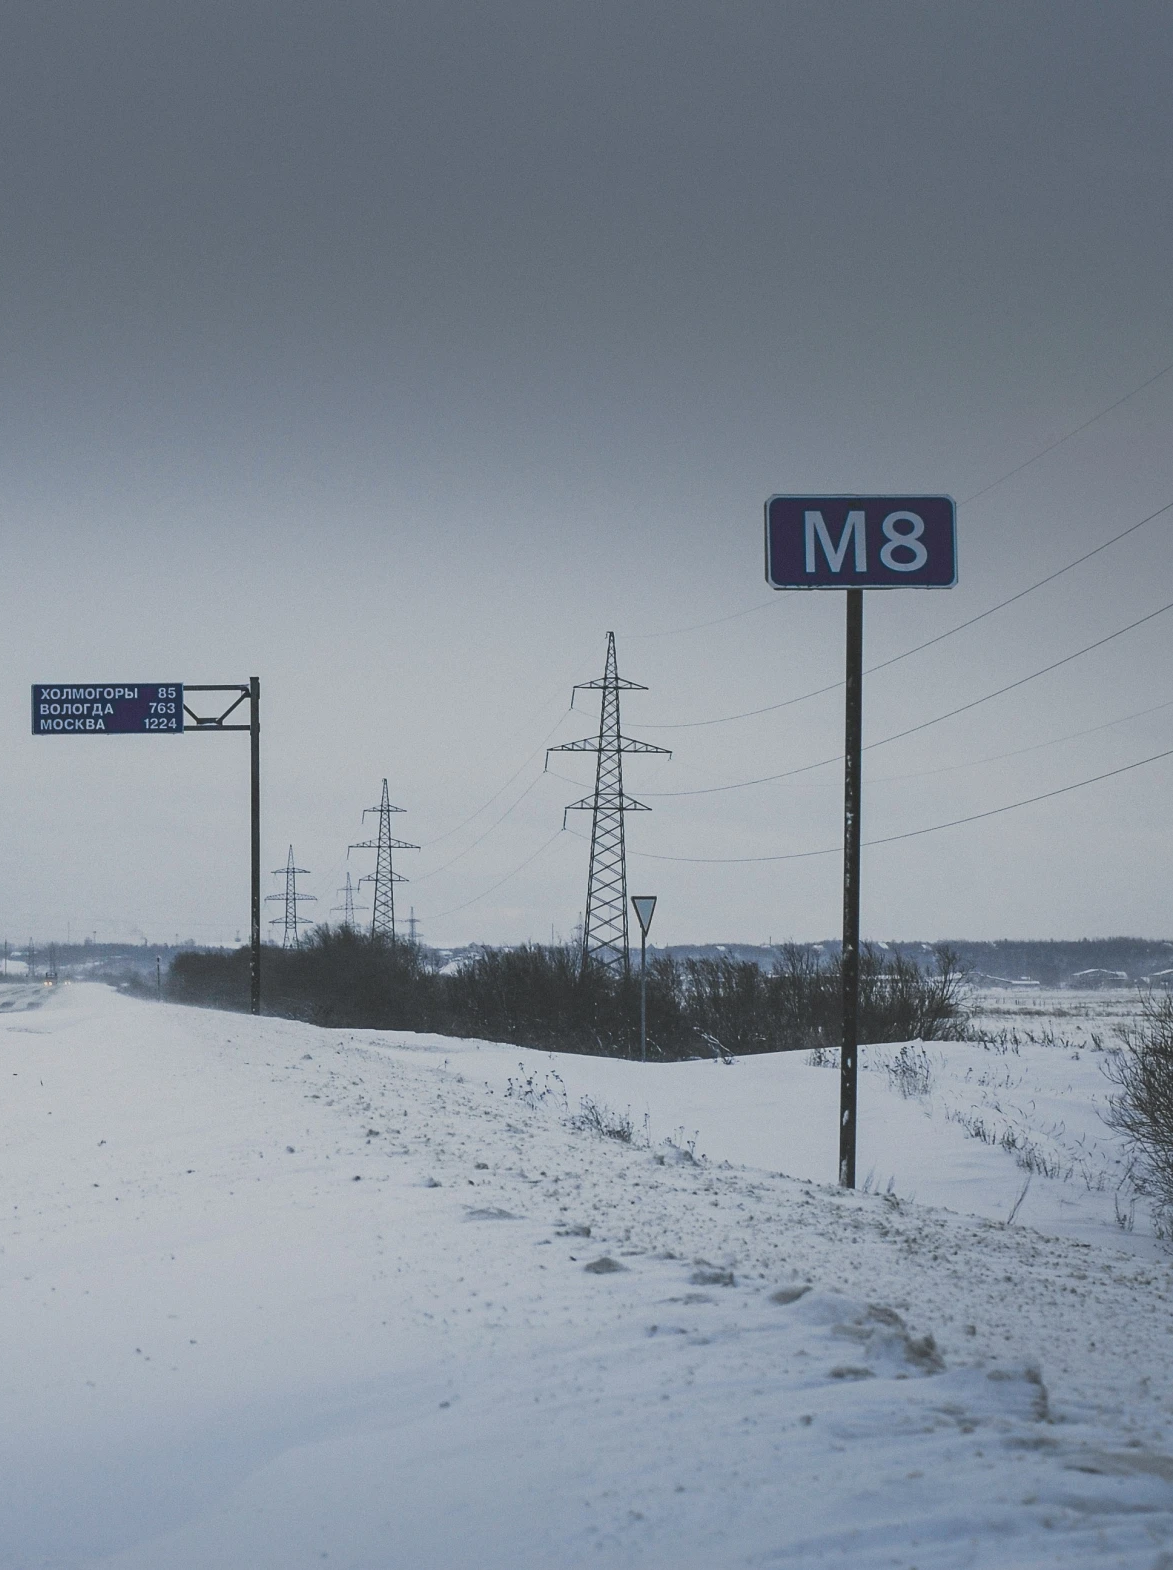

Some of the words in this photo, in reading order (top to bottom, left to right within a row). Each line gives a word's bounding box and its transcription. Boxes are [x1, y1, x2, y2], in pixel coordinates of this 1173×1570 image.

[41, 688, 138, 700] ХОЛМОГОРЫ
[158, 687, 176, 699] 85
[40, 703, 114, 716] ВОЛОГДА
[149, 703, 176, 714] 763
[40, 718, 105, 730] МОСКВА
[144, 718, 177, 729] 1224
